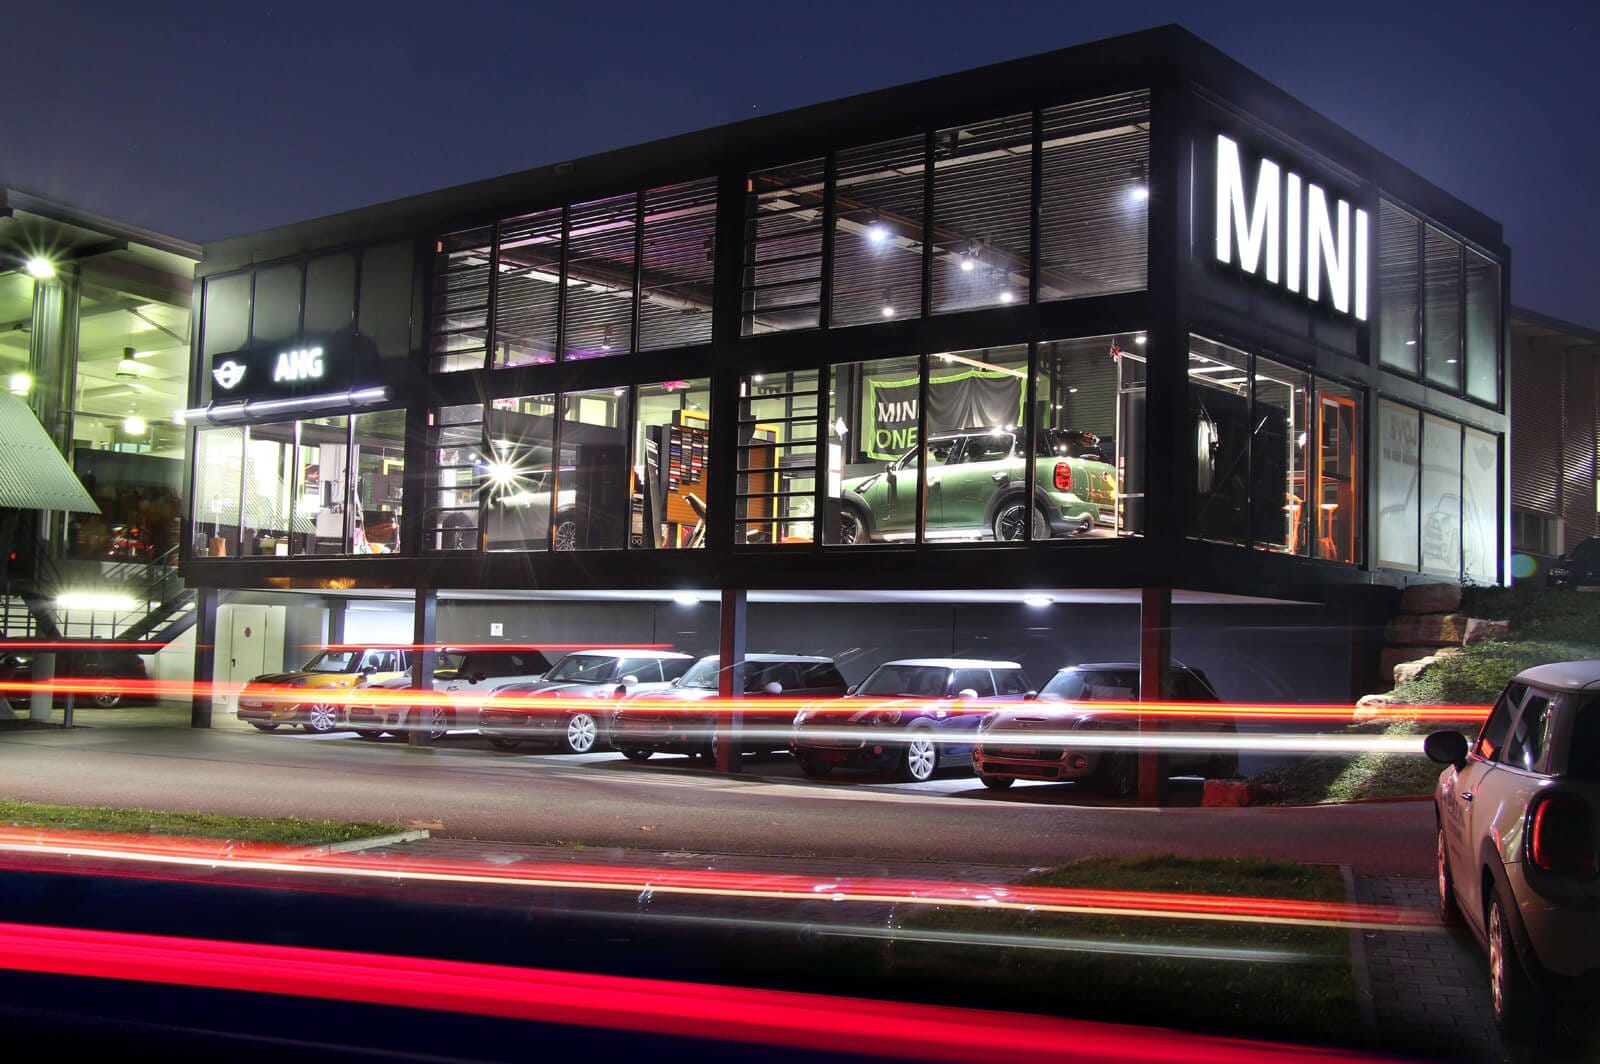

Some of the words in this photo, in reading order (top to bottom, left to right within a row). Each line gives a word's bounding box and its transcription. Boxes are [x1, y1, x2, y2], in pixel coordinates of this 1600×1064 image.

[1216, 135, 1368, 320] MINI
[274, 347, 323, 381] AHG
[878, 427, 918, 449] ONE
